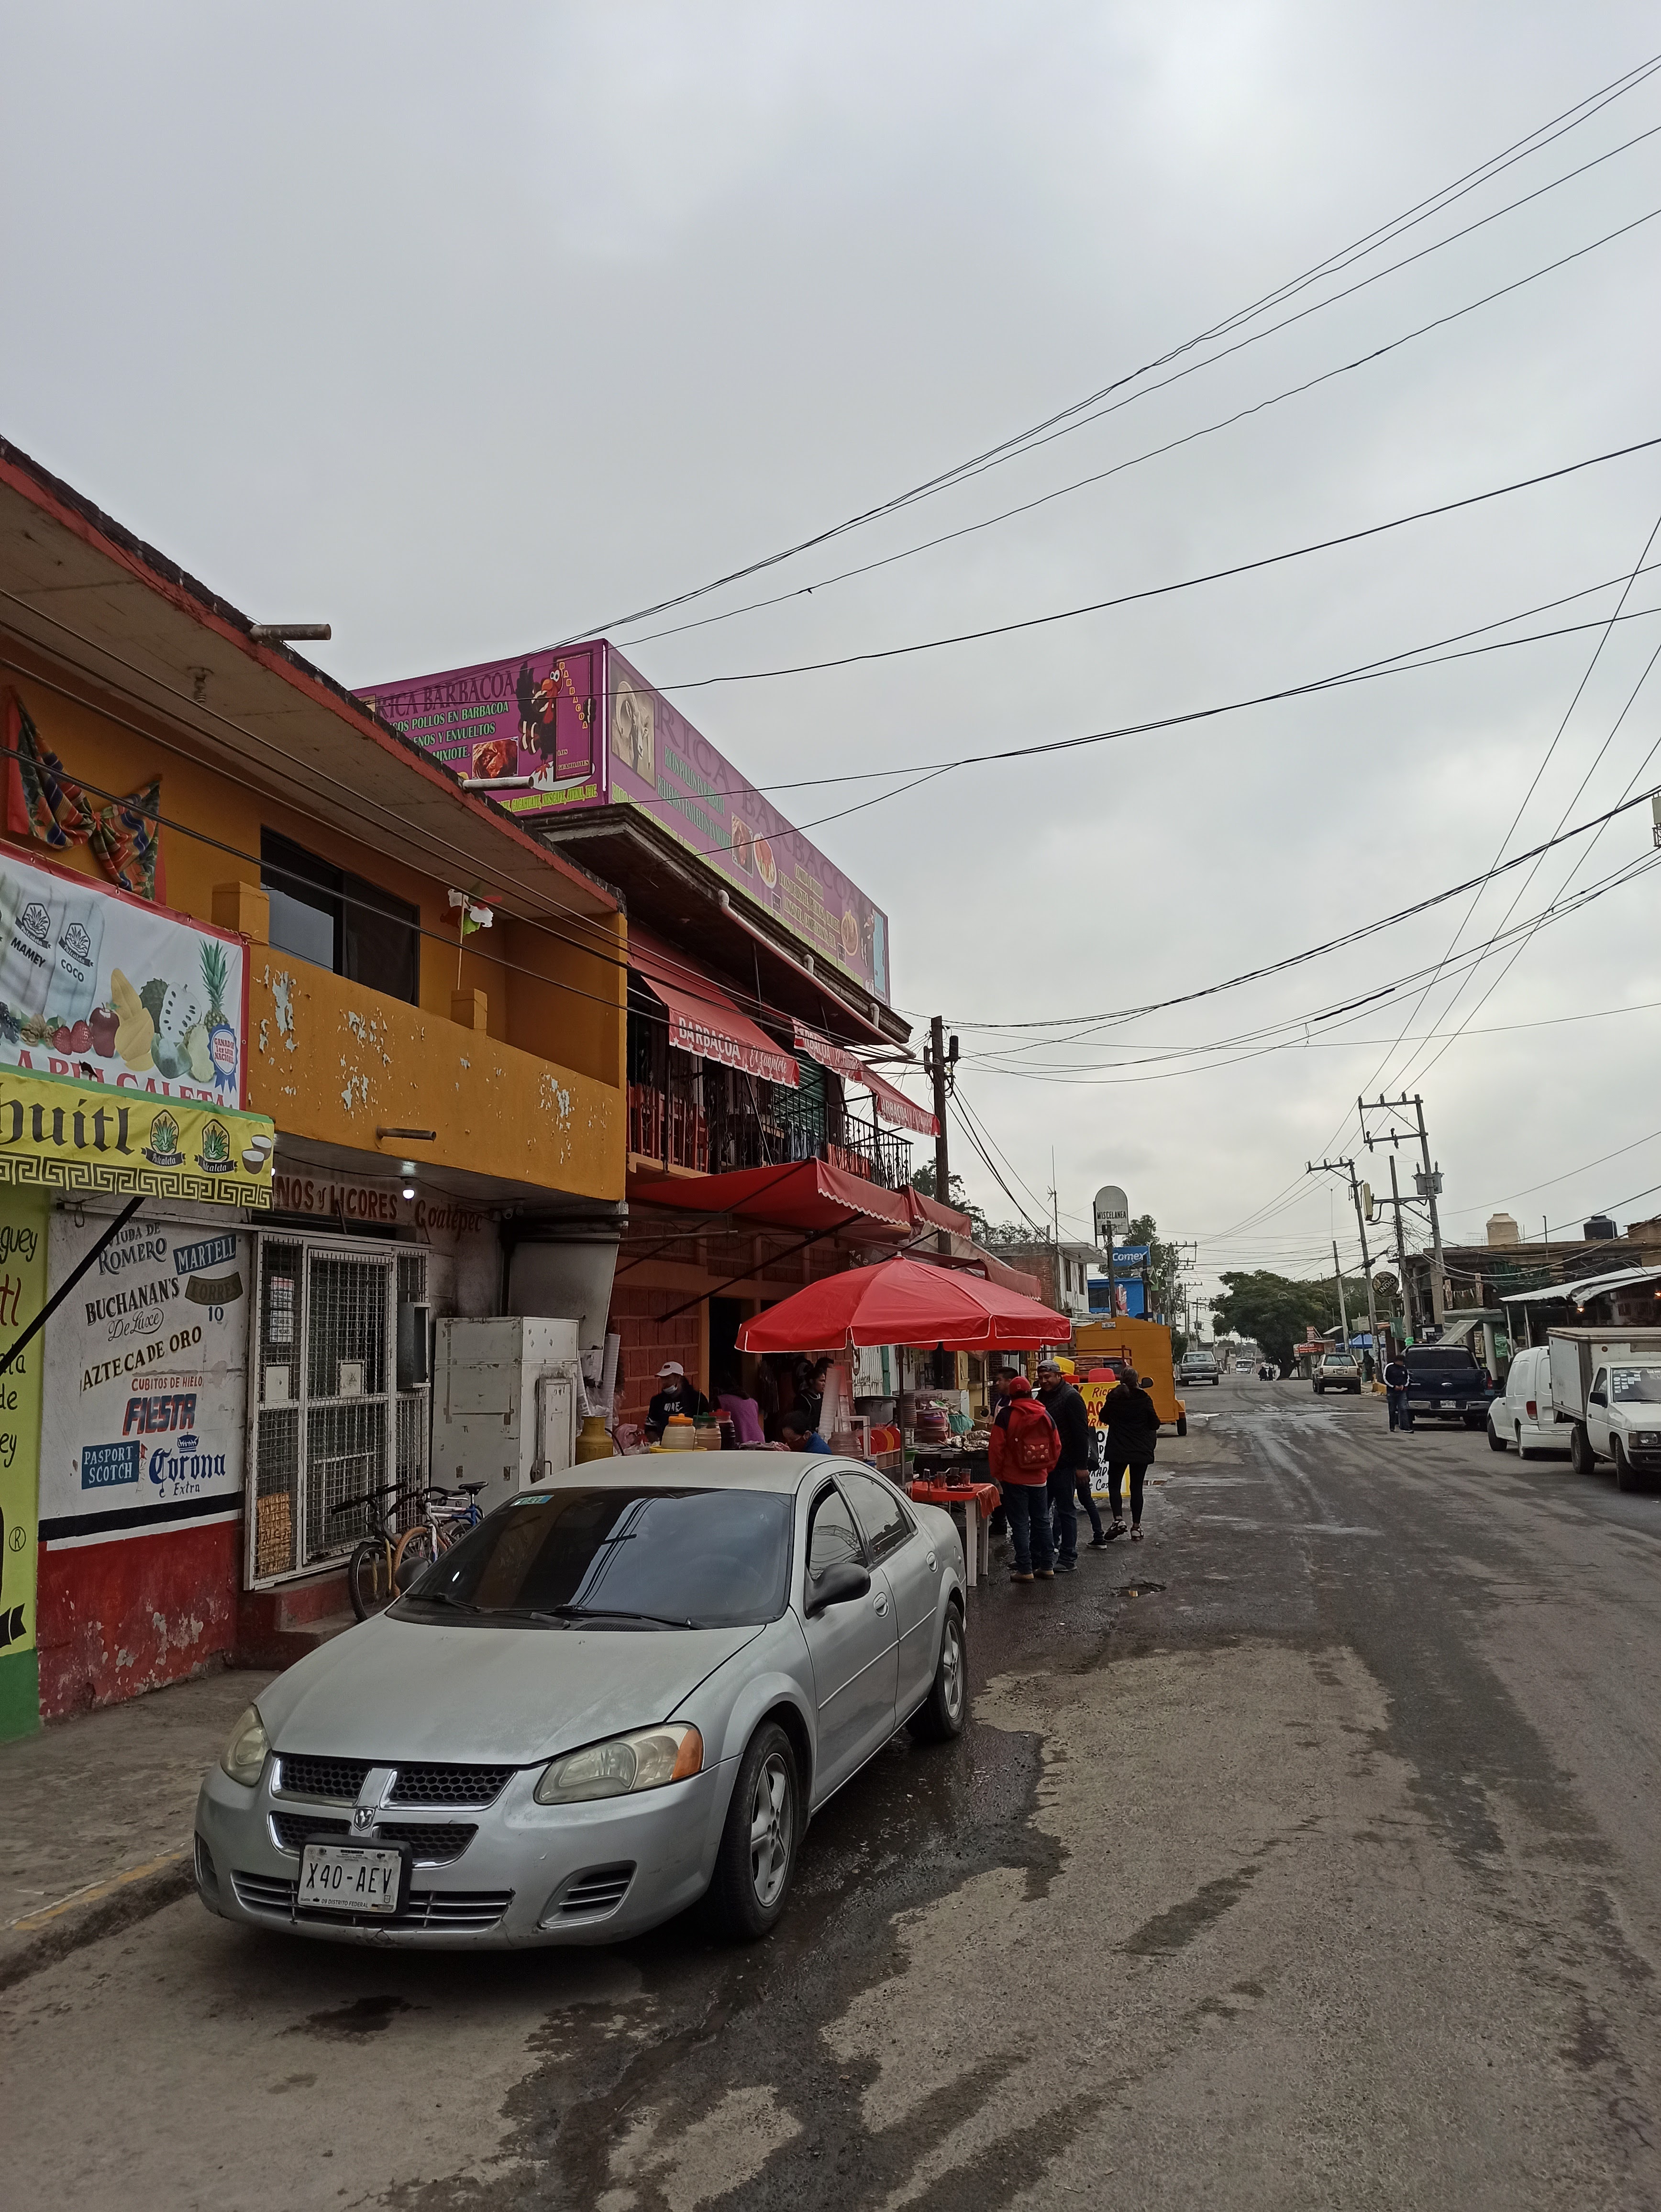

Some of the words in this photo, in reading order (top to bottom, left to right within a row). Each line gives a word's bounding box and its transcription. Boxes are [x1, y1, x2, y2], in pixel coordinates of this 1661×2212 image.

[423, 671, 517, 712] BARBACOA
[390, 720, 410, 733] COS
[412, 713, 445, 730] POLLOS
[448, 711, 459, 723] EN
[462, 701, 509, 720] BARBACOA
[410, 733, 436, 747] ENOS
[438, 731, 444, 743] Y
[446, 722, 495, 741] ENVUELTOS
[655, 692, 733, 799] RICA
[665, 745, 679, 777] RICOS
[680, 759, 697, 792] POLLOS
[11, 937, 46, 968] MAMEY
[61, 959, 84, 982] COCO
[678, 1017, 742, 1061] BARBACOA
[330, 1185, 399, 1220] LICORES
[1097, 1211, 1127, 1220] MISCELANEA
[145, 1221, 161, 1237] DE
[99, 1238, 167, 1275] ROMERO
[177, 1237, 236, 1273] MARTELL
[1112, 1251, 1148, 1262] Comex
[85, 1277, 180, 1326] BUCHANAN'S
[1379, 1278, 1395, 1294] INDIO
[208, 1306, 223, 1322] 10
[82, 1349, 145, 1392] AZTECA
[147, 1340, 165, 1363] DE
[169, 1326, 202, 1352] ORO
[131, 1377, 167, 1392] CUBITOS
[170, 1377, 180, 1388] DE
[183, 1376, 203, 1388] HIELO
[122, 1393, 197, 1436] FIESTA
[84, 1445, 133, 1465] PASPORT
[149, 1448, 226, 1486] Corona
[89, 1462, 133, 1484] SCOTCH
[173, 1482, 200, 1496] Extra
[306, 1863, 393, 1894] X40-AEV
